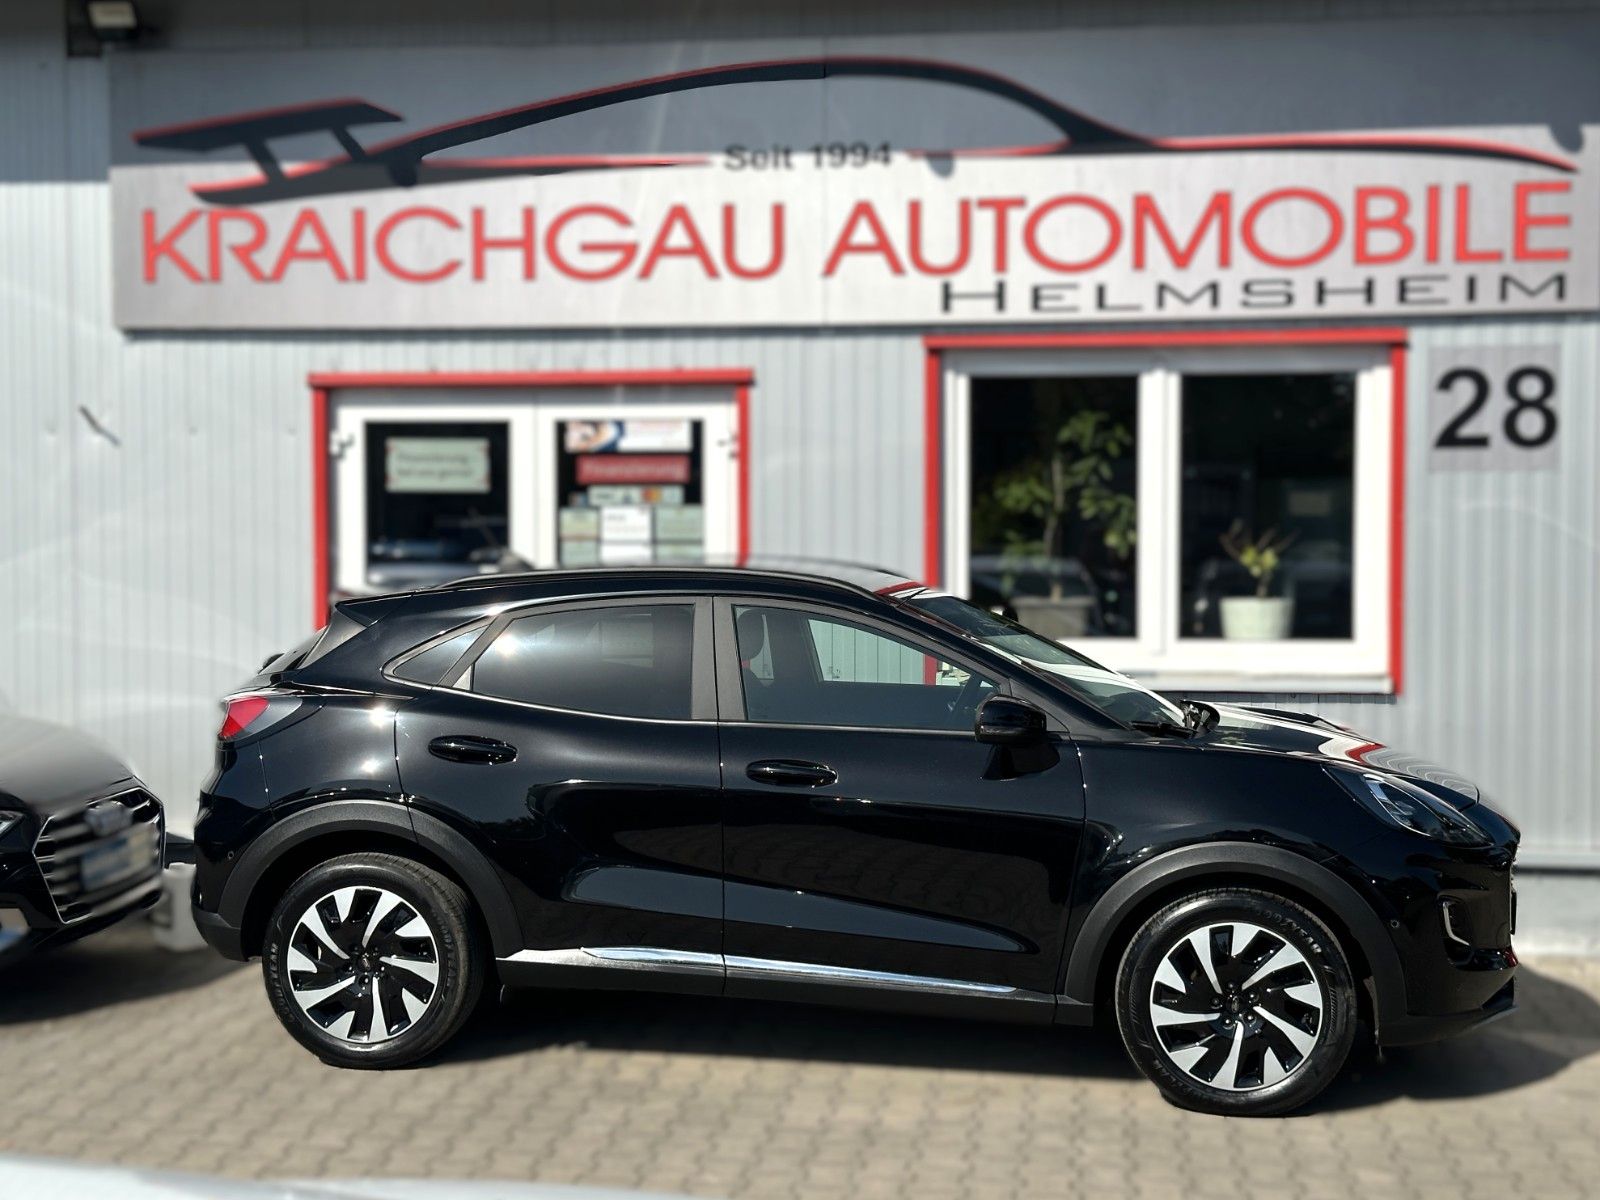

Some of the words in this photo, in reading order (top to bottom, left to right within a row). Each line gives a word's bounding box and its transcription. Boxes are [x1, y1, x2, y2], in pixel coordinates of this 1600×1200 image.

[723, 143, 793, 171] Seit
[811, 141, 892, 169] 1994
[142, 202, 785, 284] KRAICHGAU
[822, 180, 1572, 277] AUTOMOBILE
[942, 273, 1567, 312] HELMSHEIM
[1434, 365, 1558, 450] 28
